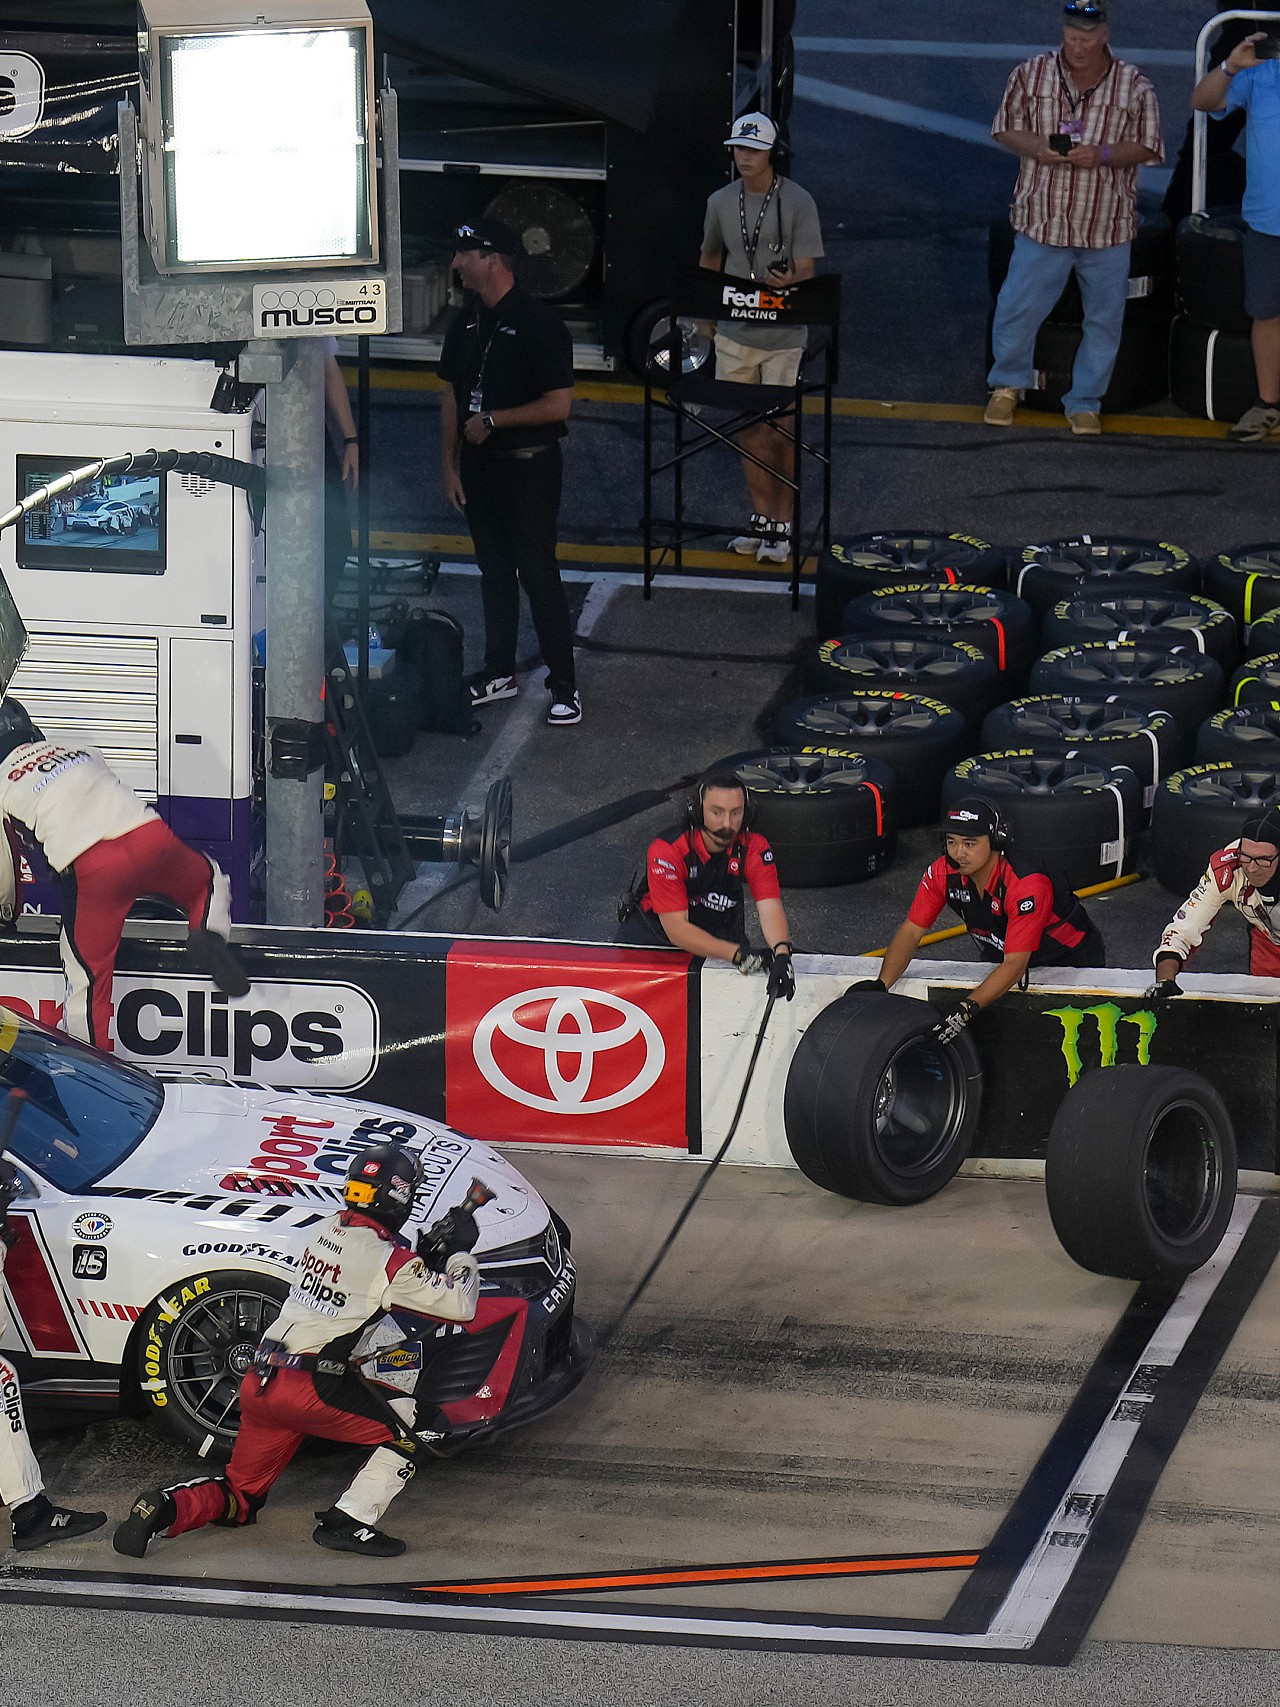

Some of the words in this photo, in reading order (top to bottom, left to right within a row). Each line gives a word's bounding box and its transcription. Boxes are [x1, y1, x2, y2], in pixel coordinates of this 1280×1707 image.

[722, 285, 785, 310] FedEx
[731, 308, 777, 320] RACING
[872, 583, 992, 597] GOODYEAR
[801, 745, 864, 759] EAGLE
[182, 1242, 300, 1269] GOODYEA
[300, 1246, 342, 1284] Sport
[300, 1272, 347, 1308] Clips
[542, 1257, 577, 1313] CAMRY
[379, 1350, 419, 1365] SUNOCO
[3, 1380, 24, 1434] Clips
[50, 1513, 71, 1527] N
[353, 1527, 375, 1542] N
